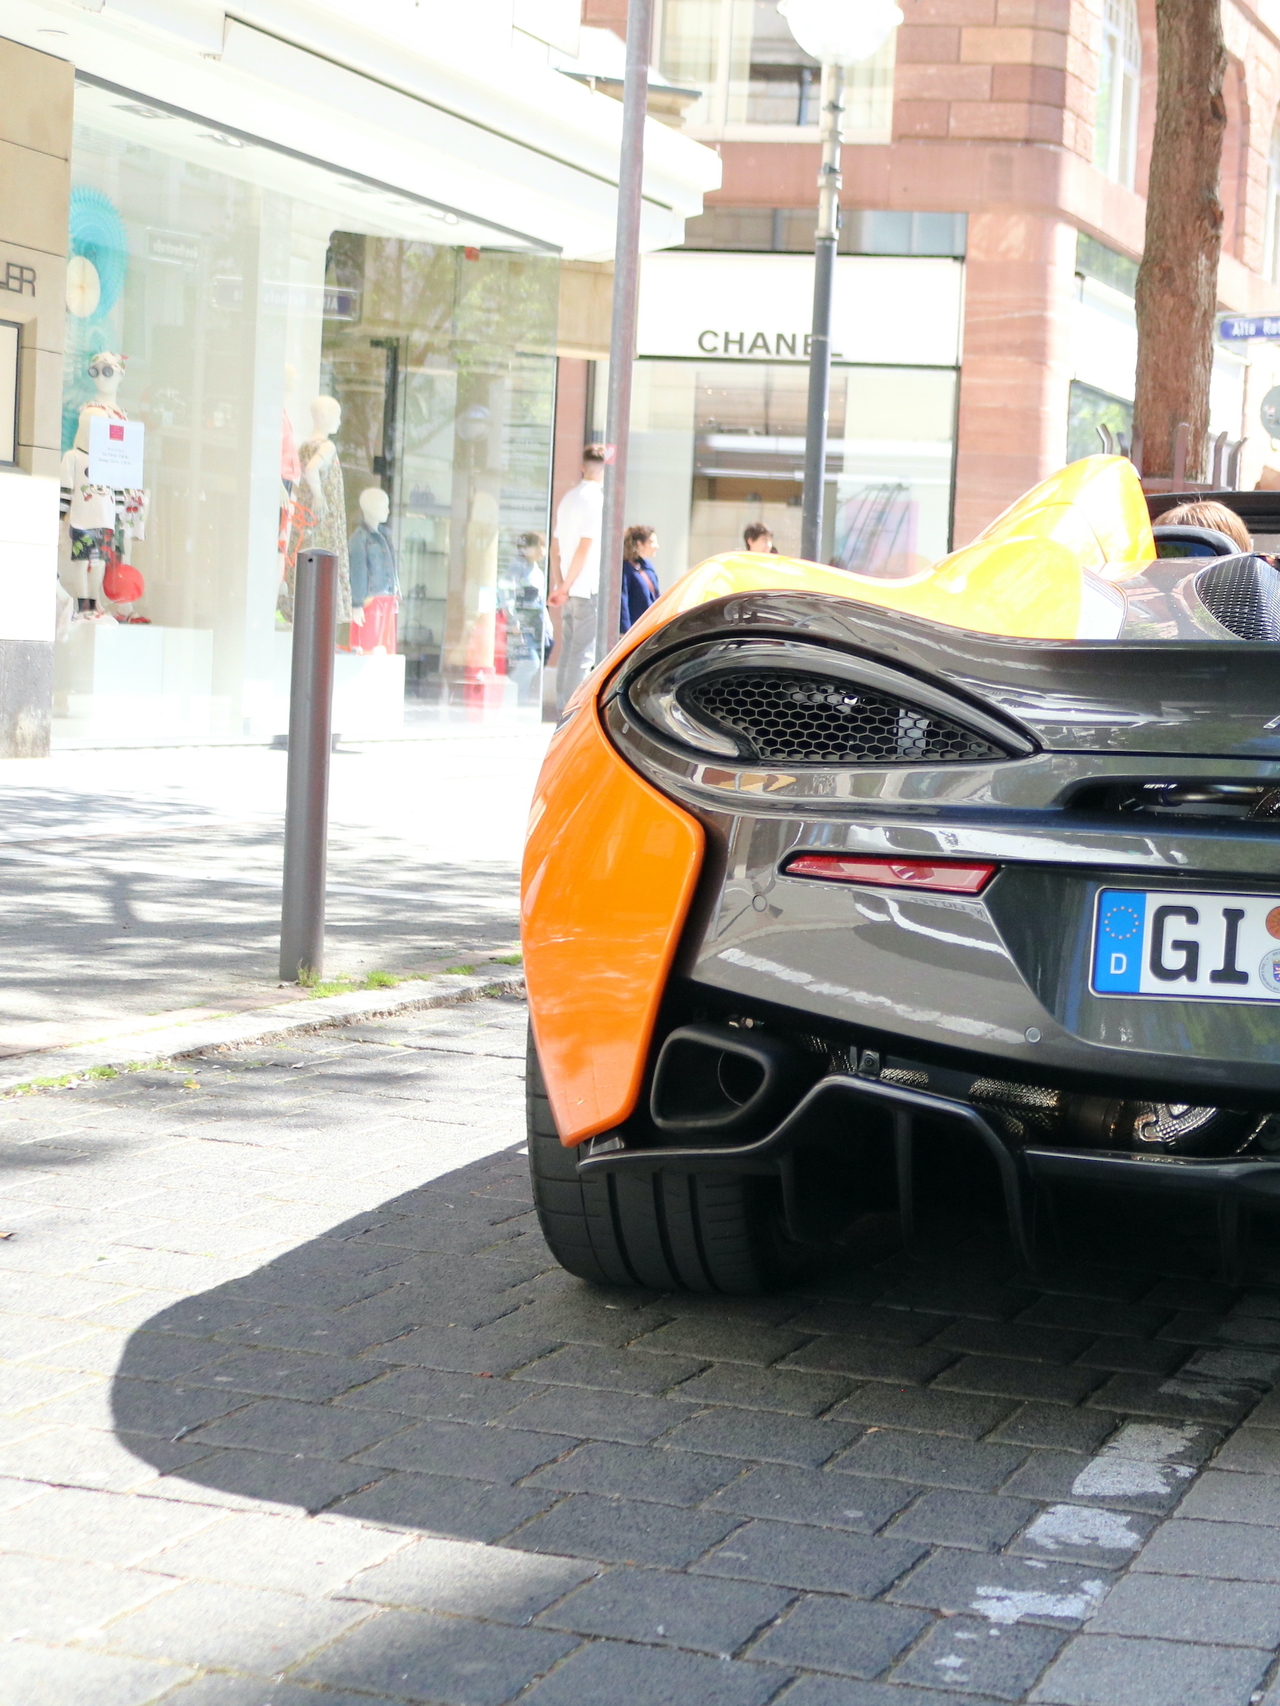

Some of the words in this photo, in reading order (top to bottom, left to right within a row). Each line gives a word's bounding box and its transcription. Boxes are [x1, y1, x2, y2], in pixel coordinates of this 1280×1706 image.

[1232, 321, 1255, 336] Alte
[1149, 905, 1250, 985] GI
[1109, 953, 1127, 975] D
